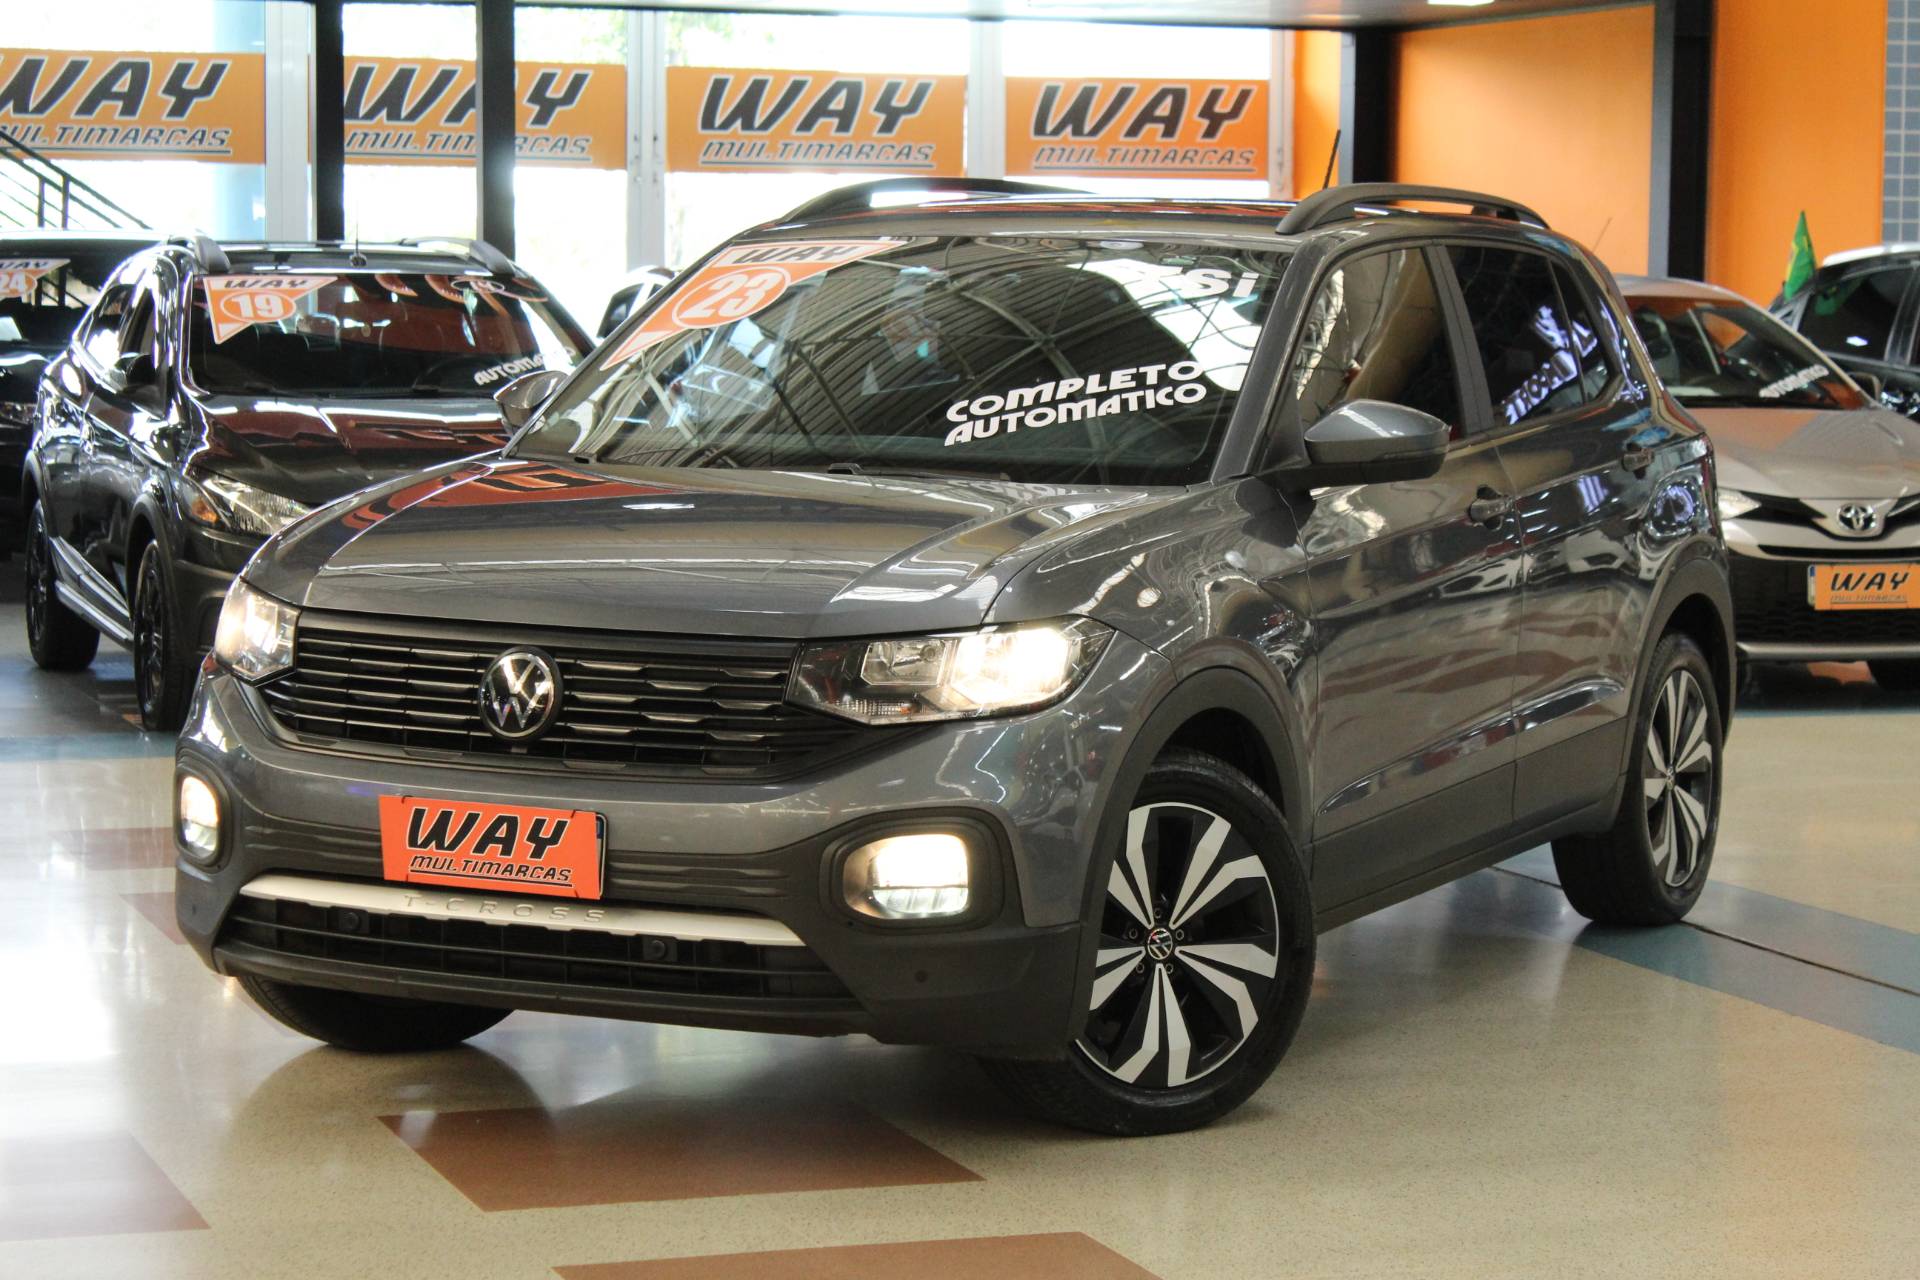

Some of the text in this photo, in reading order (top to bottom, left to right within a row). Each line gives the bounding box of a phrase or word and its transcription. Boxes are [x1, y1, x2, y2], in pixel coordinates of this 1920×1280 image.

[699, 75, 937, 136] WAY
[1032, 83, 1256, 140] WAY
[0, 125, 230, 147] ULTIMARCAS
[702, 140, 936, 163] MULTIMARCAS
[1034, 147, 1256, 167] MULTIMARCAS
[732, 246, 862, 263] WAY
[224, 279, 308, 288] WAY
[679, 271, 784, 319] 23
[231, 293, 284, 318] 19
[946, 360, 1204, 422] COMPLETO
[944, 382, 1207, 447] AUTOMATICO
[1831, 572, 1910, 591] WAY
[406, 806, 572, 861] WAY
[409, 855, 573, 882] MULTIMARCAS
[404, 893, 605, 923] T-CROSS
